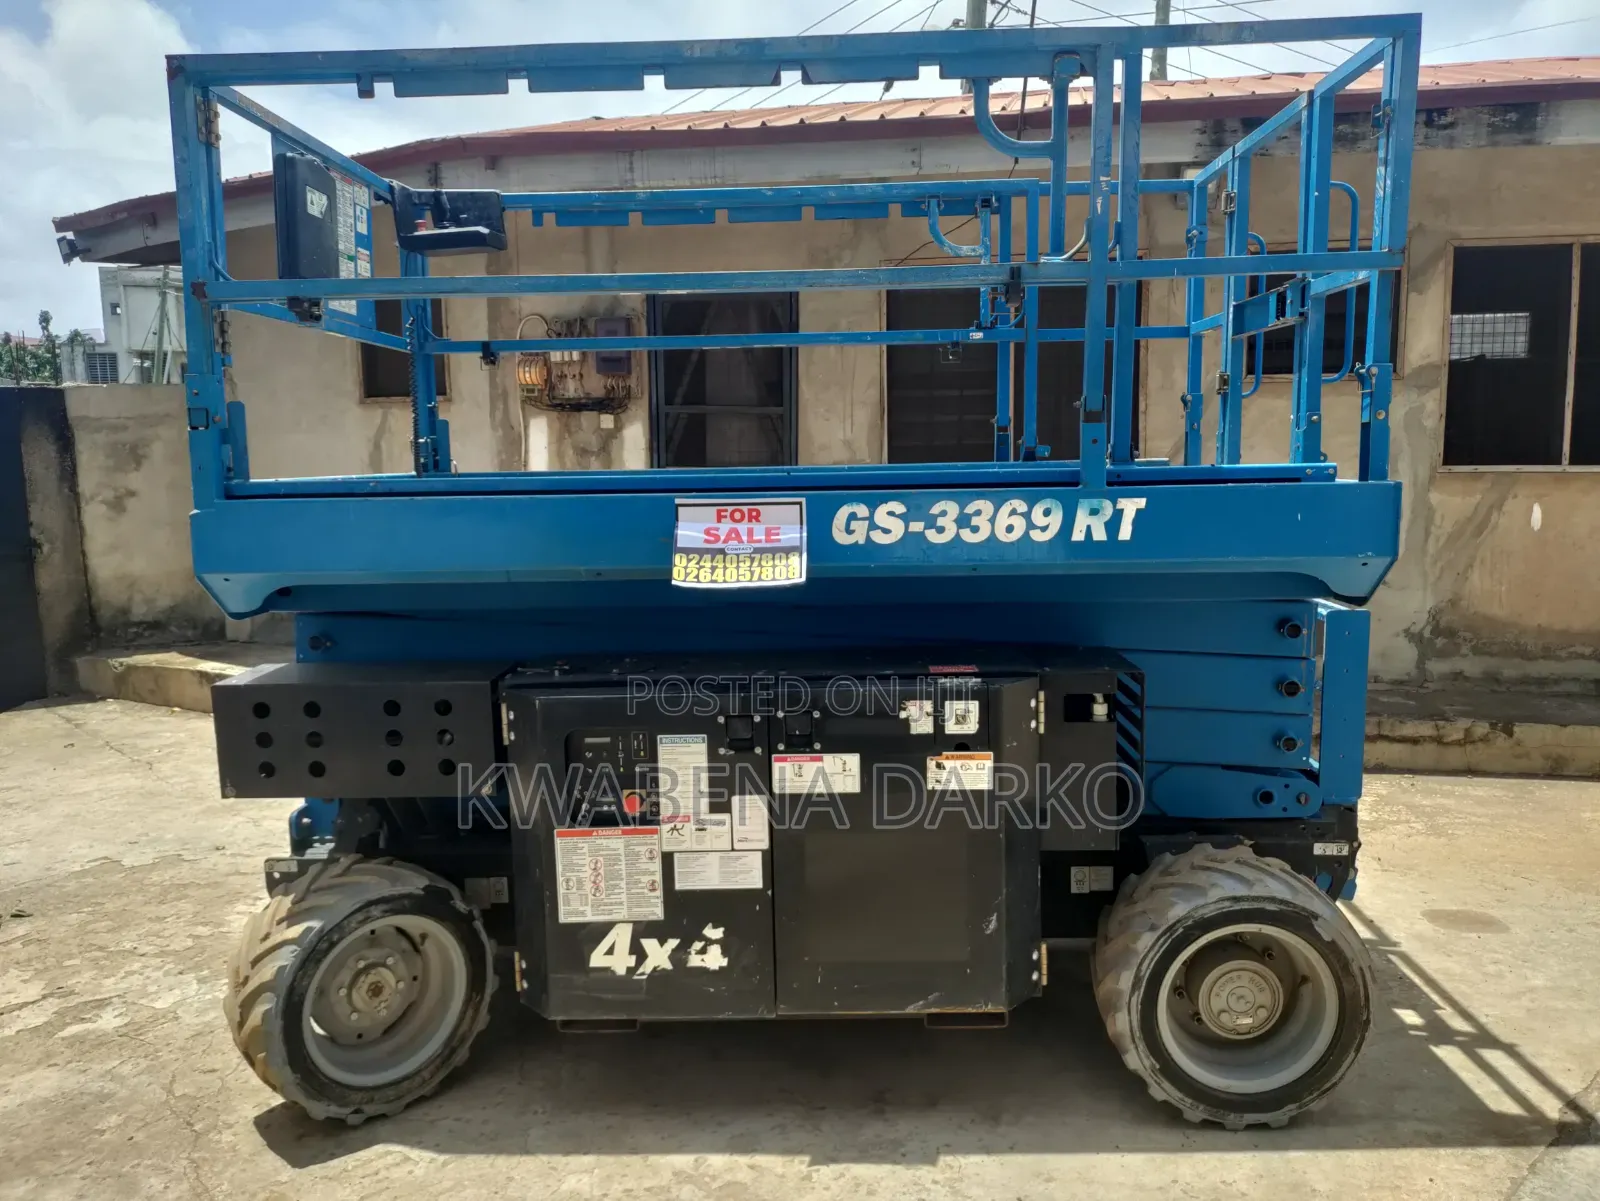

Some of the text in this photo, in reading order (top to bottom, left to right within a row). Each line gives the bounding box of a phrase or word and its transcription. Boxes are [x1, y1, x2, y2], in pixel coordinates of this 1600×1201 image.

[716, 507, 762, 523] FOR
[831, 497, 1147, 545] GS-3369 RT
[703, 526, 782, 545] SALE
[674, 552, 800, 568] 0244057808
[672, 565, 800, 582] 0264057808
[661, 736, 703, 744] INSTRUCTIONS
